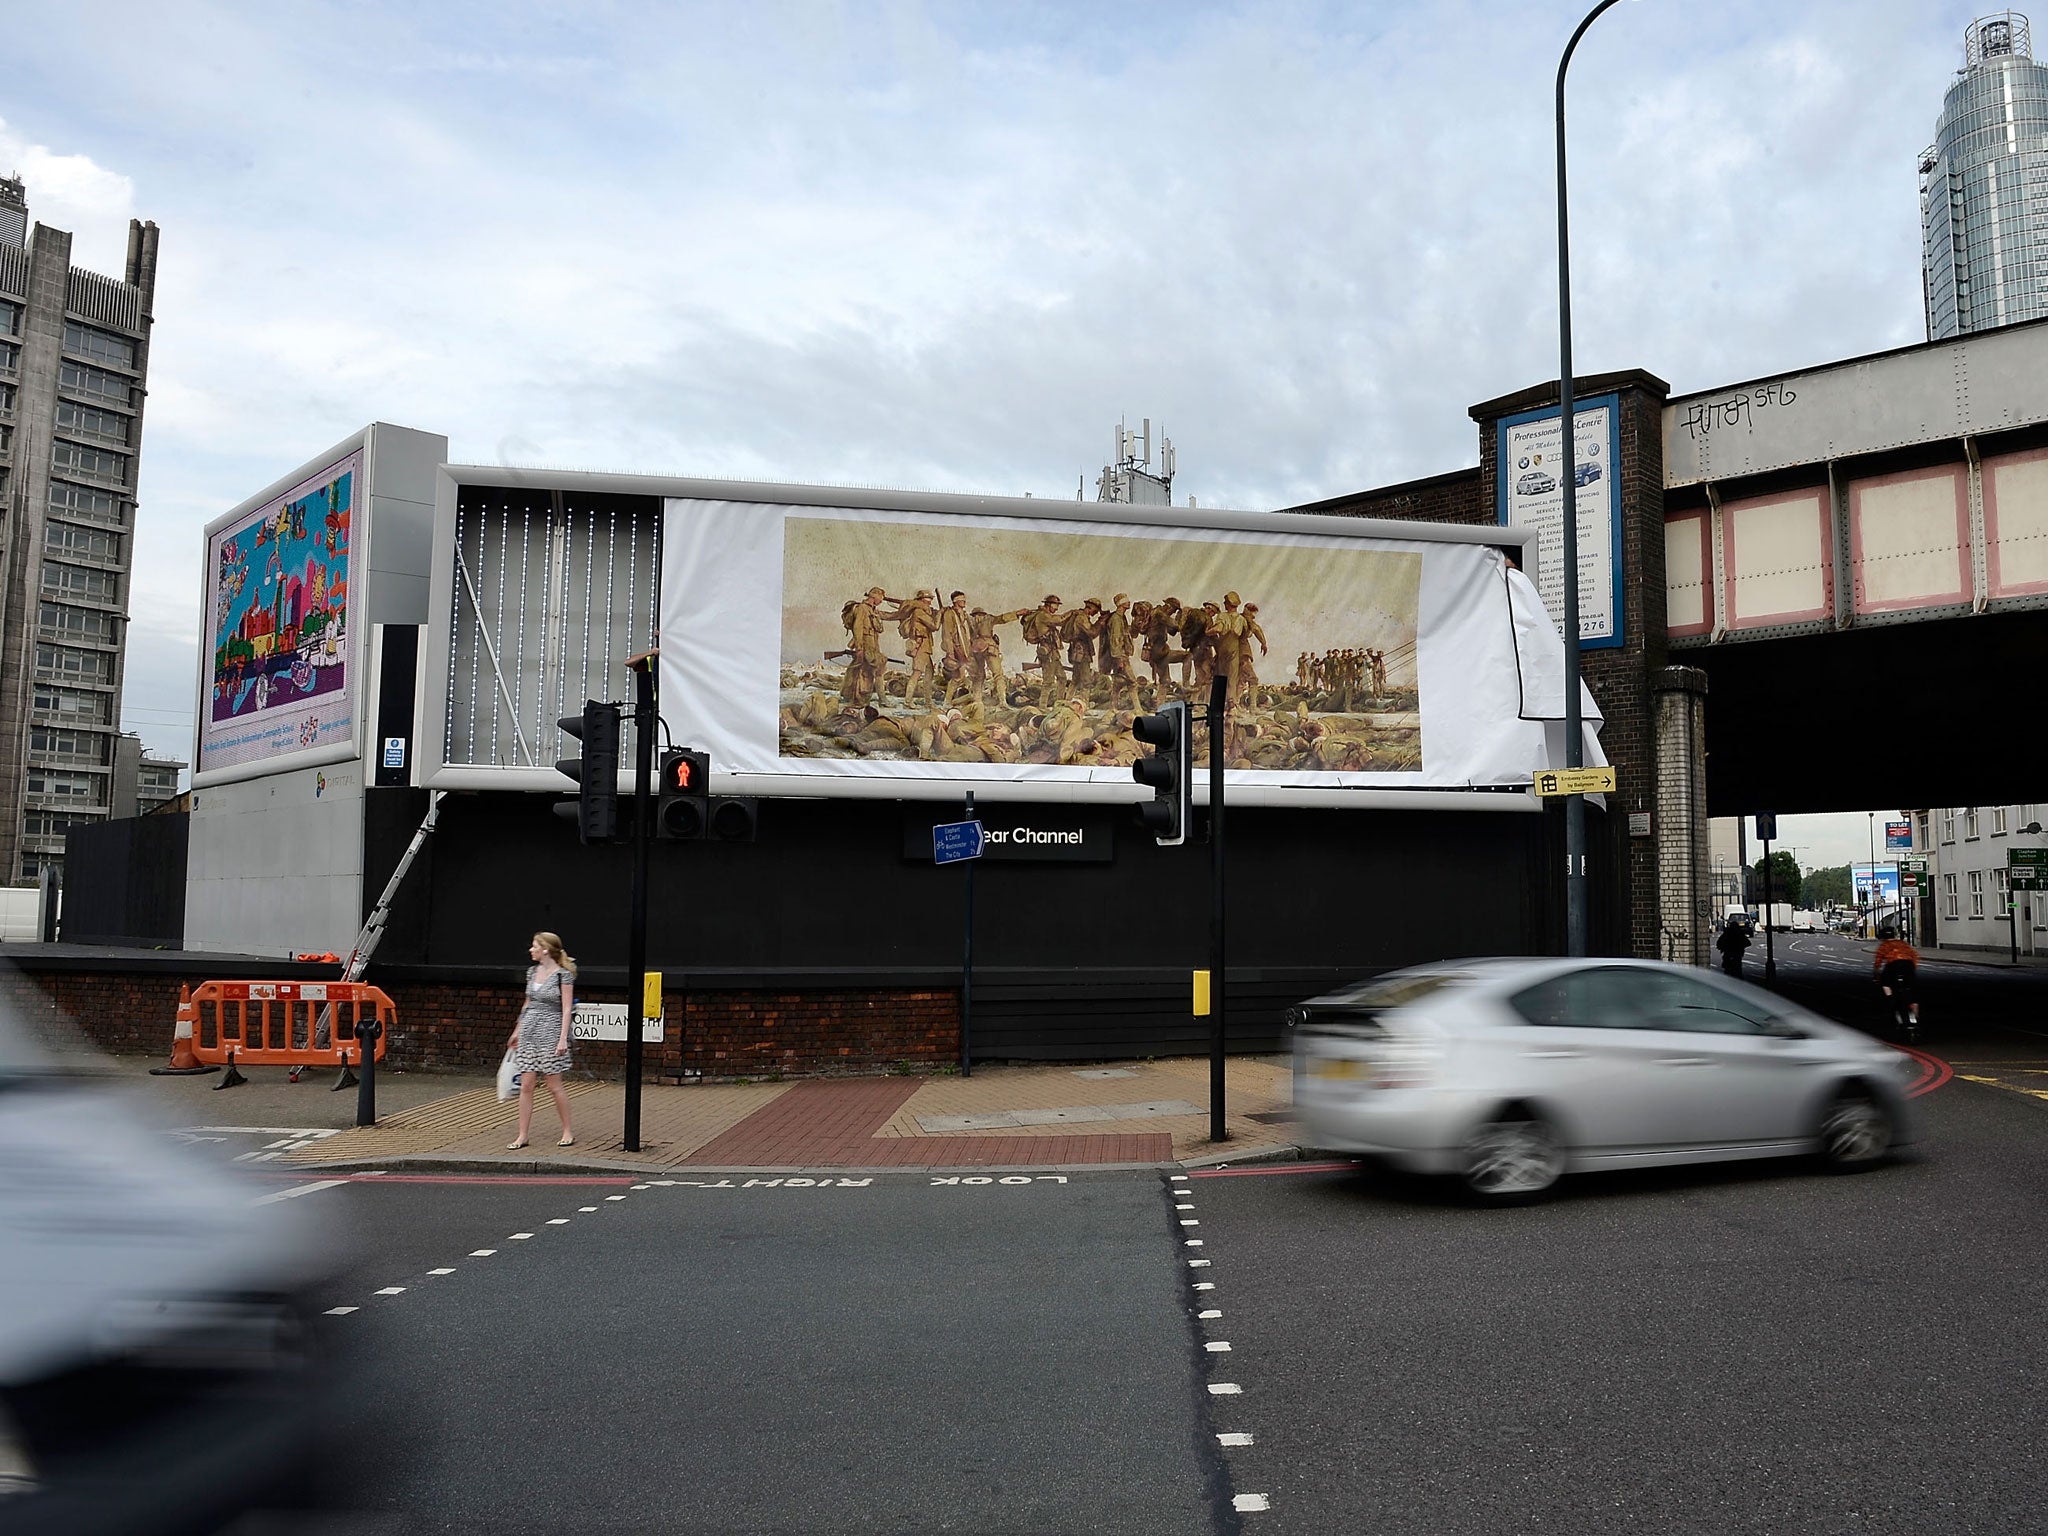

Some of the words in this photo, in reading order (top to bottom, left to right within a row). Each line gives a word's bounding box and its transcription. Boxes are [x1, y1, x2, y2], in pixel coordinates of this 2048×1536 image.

[1524, 515, 1555, 525] DIAGNOSTICS
[984, 830, 1010, 844] ear
[1012, 827, 1083, 844] Channel
[573, 1013, 604, 1026] OUTH
[573, 1026, 598, 1038] OAD
[698, 1178, 873, 1188] RIGHT
[930, 1176, 1068, 1186] LOOK
